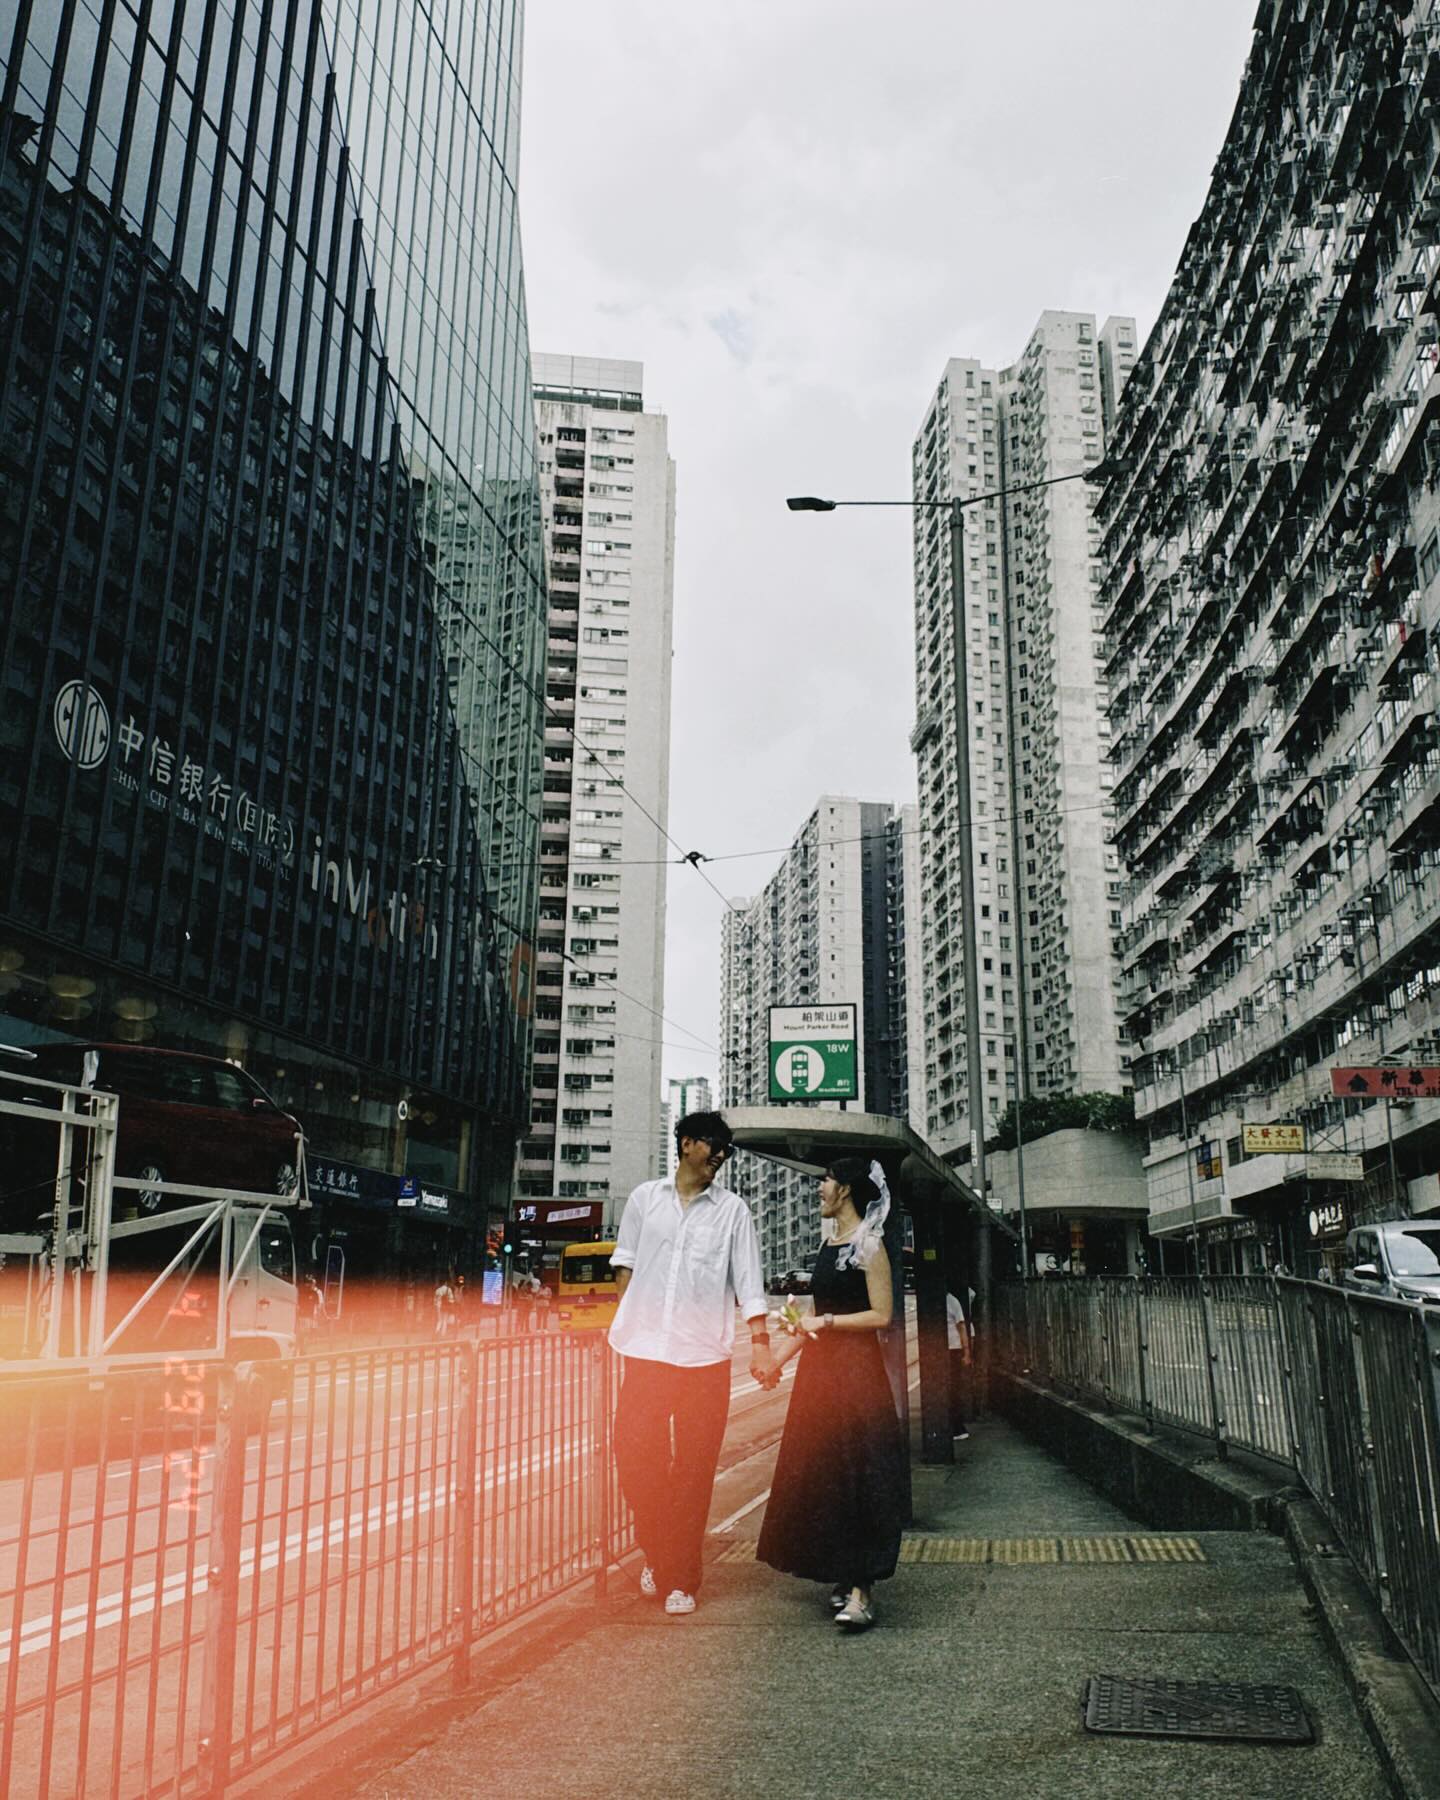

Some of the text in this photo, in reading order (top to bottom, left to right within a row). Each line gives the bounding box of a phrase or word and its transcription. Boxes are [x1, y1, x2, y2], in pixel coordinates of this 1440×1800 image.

[182, 806, 210, 834] BAK
[826, 1044, 850, 1053] 18W
[1246, 1127, 1301, 1139] 大發文具
